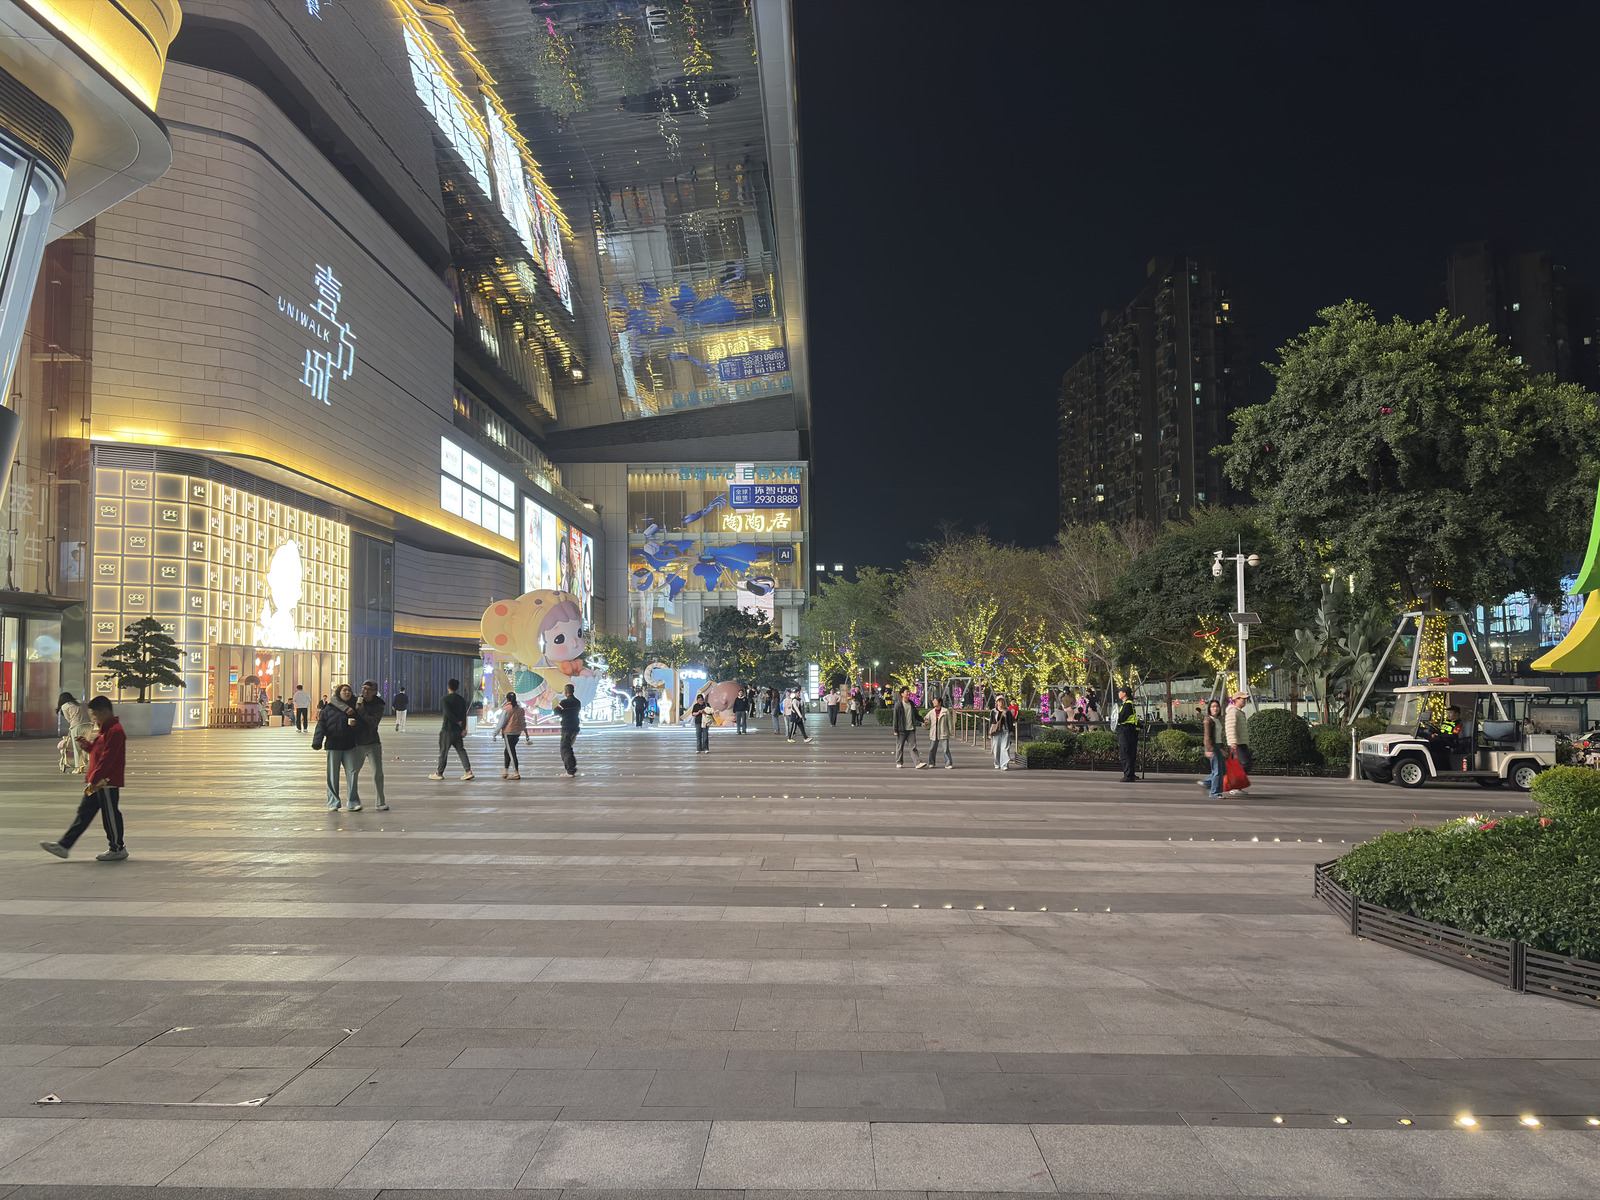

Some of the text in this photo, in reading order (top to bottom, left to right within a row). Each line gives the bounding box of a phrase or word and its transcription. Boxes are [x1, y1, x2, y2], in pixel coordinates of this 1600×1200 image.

[277, 295, 331, 344] UNIWALK
[678, 466, 801, 481] 壹城中心 自有天地
[754, 495, 798, 504] 2930 8888
[722, 512, 791, 533] 陶陶居
[780, 551, 790, 559] AI
[1452, 631, 1467, 652] P
